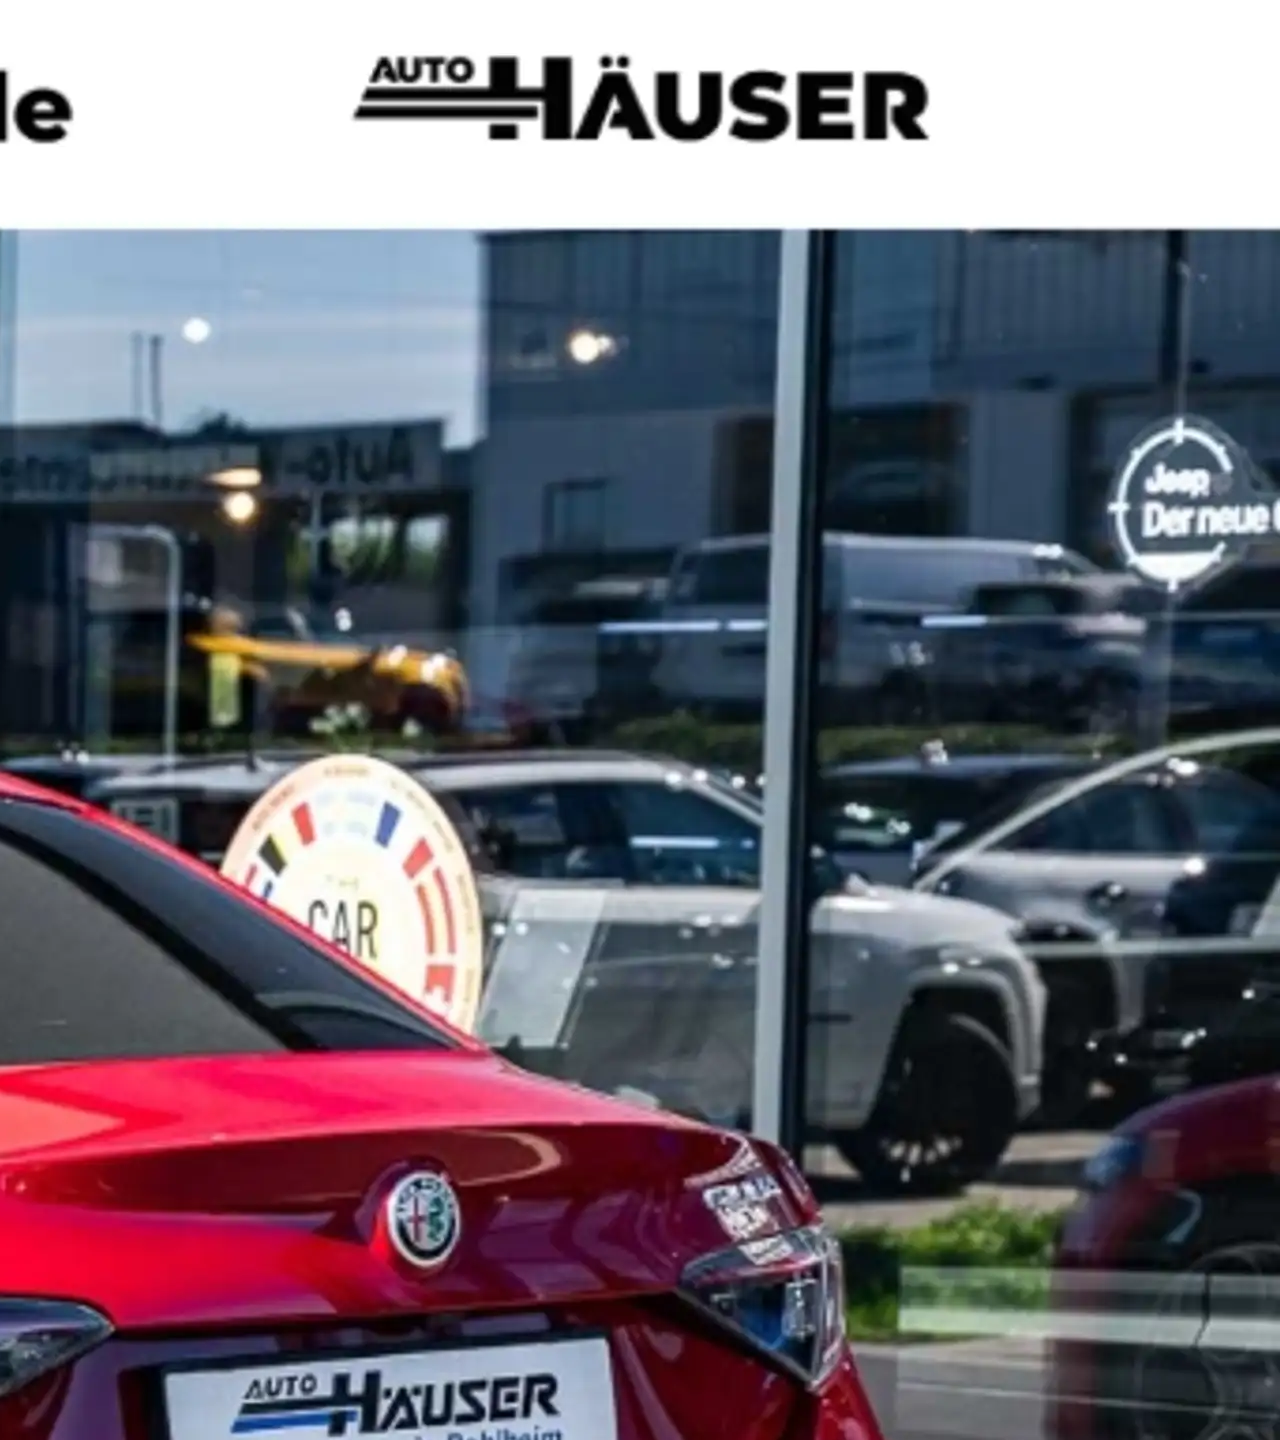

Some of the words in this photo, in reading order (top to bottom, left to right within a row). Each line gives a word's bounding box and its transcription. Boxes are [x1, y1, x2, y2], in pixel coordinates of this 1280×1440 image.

[1144, 462, 1211, 499] Jeep
[1142, 501, 1196, 538] Der
[1197, 503, 1271, 536] neue
[244, 1375, 318, 1400] AUTO
[328, 1369, 561, 1437] HÄUSER
